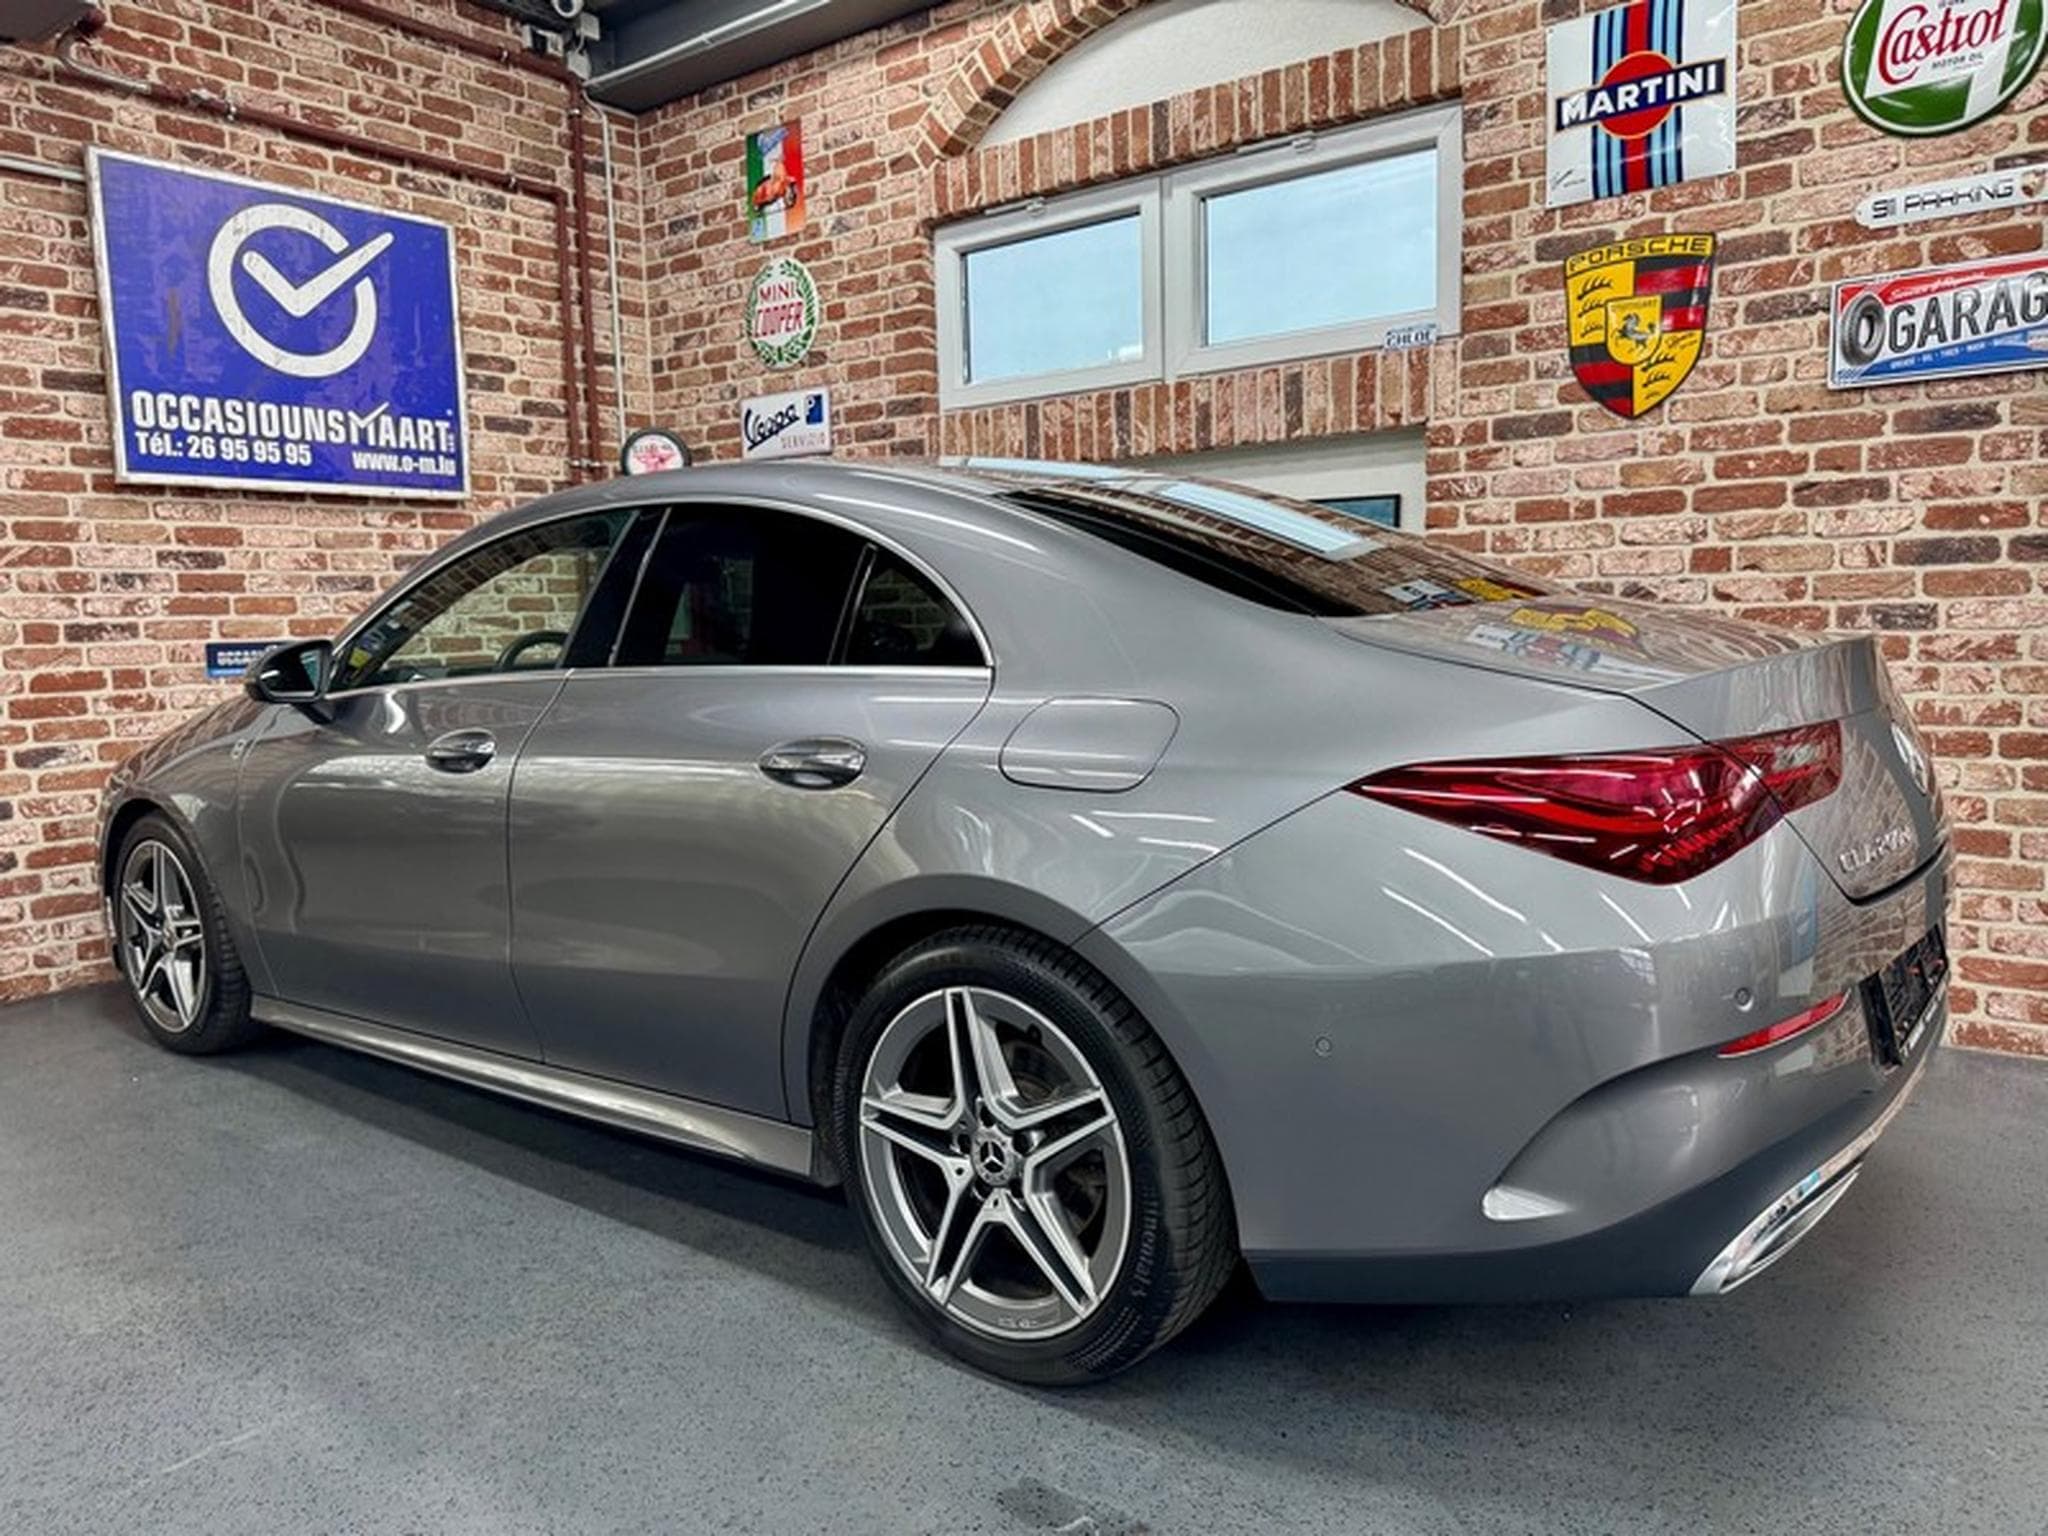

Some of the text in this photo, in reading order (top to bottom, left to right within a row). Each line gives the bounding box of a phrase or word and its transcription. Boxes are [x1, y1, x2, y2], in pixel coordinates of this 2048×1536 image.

[1877, 0, 2009, 86] Castrol
[1560, 63, 1718, 127] MARTINI
[1904, 178, 2014, 215] PARKING
[1569, 236, 1709, 273] PORSCHE
[758, 279, 797, 301] MINI
[754, 300, 804, 339] COOPER
[131, 390, 452, 453] OCCASIOUNSMAART
[744, 403, 800, 451] Vespa
[186, 434, 218, 460] 26
[220, 438, 251, 463] 95
[253, 440, 284, 465] 95
[286, 442, 313, 467] 95
[352, 452, 457, 476] www.o-m.lu
